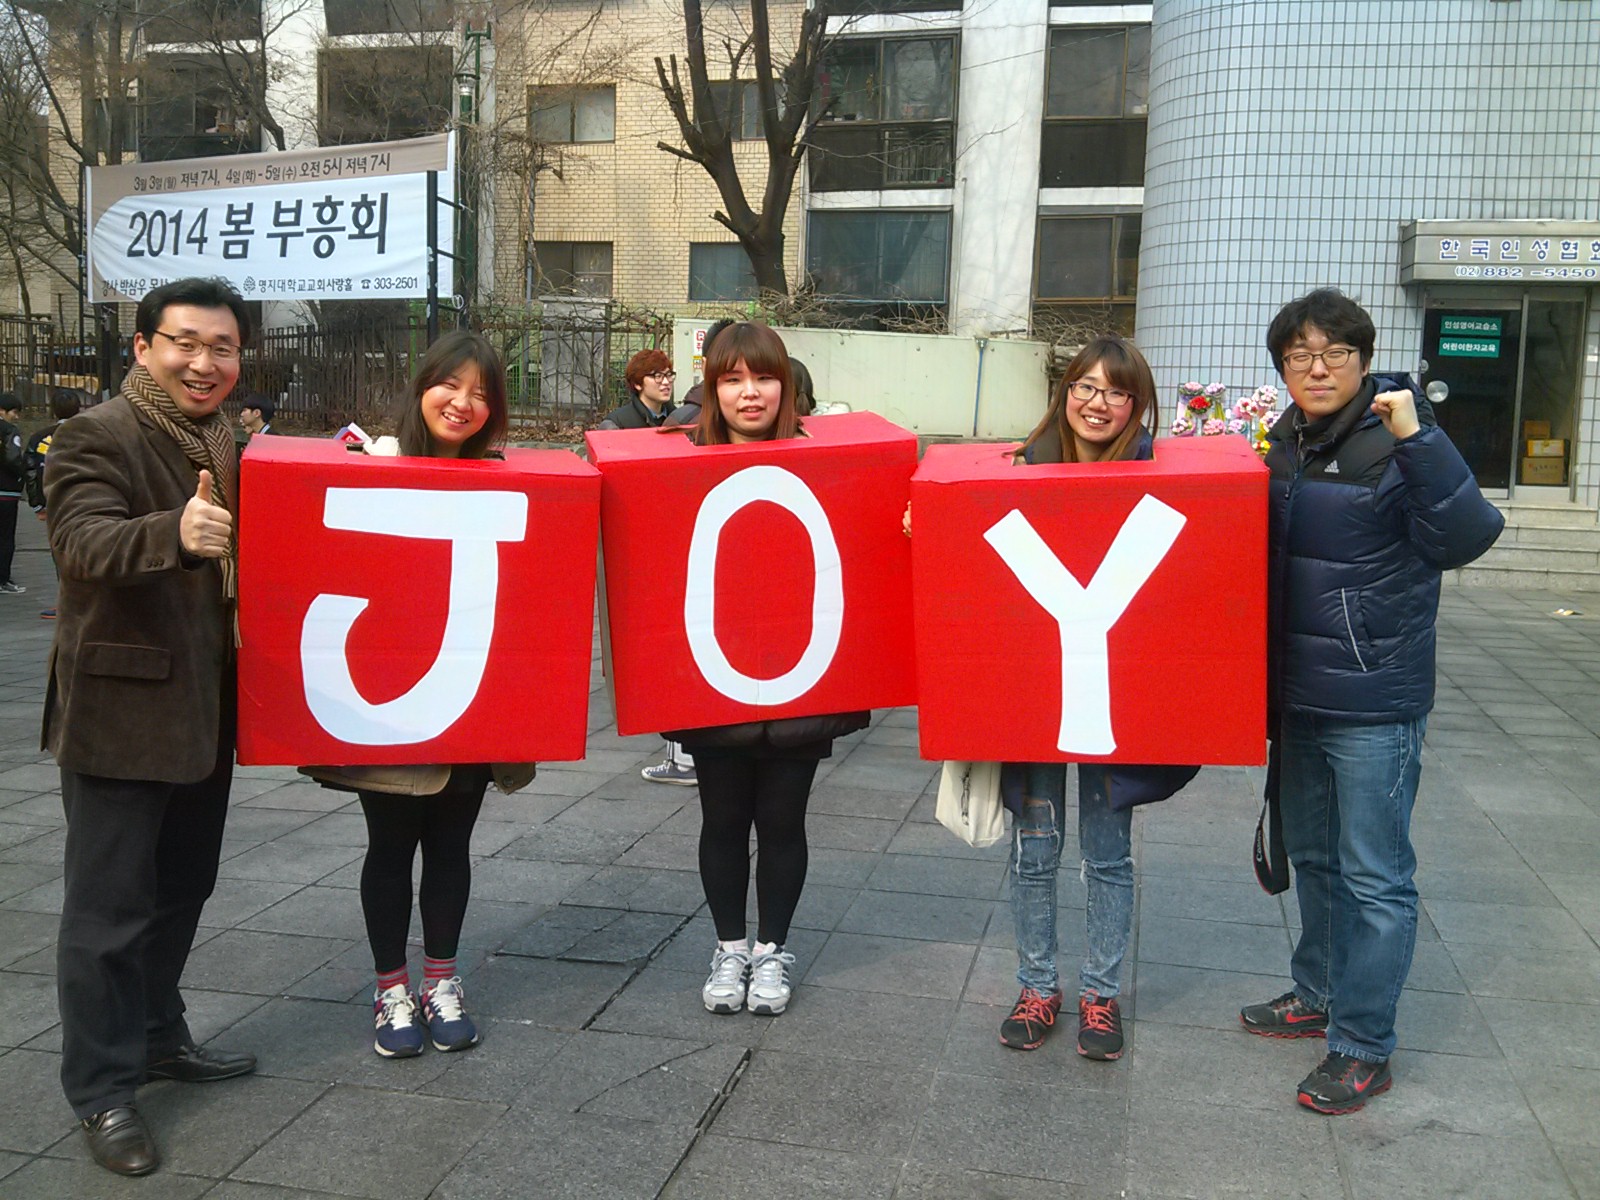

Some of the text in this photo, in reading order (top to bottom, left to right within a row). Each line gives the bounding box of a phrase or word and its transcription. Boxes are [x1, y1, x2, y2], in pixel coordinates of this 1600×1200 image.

[126, 192, 389, 260] 2014 봄 부흥회
[374, 276, 418, 290] 303-2501
[1442, 342, 1497, 353] 어린이한자교육
